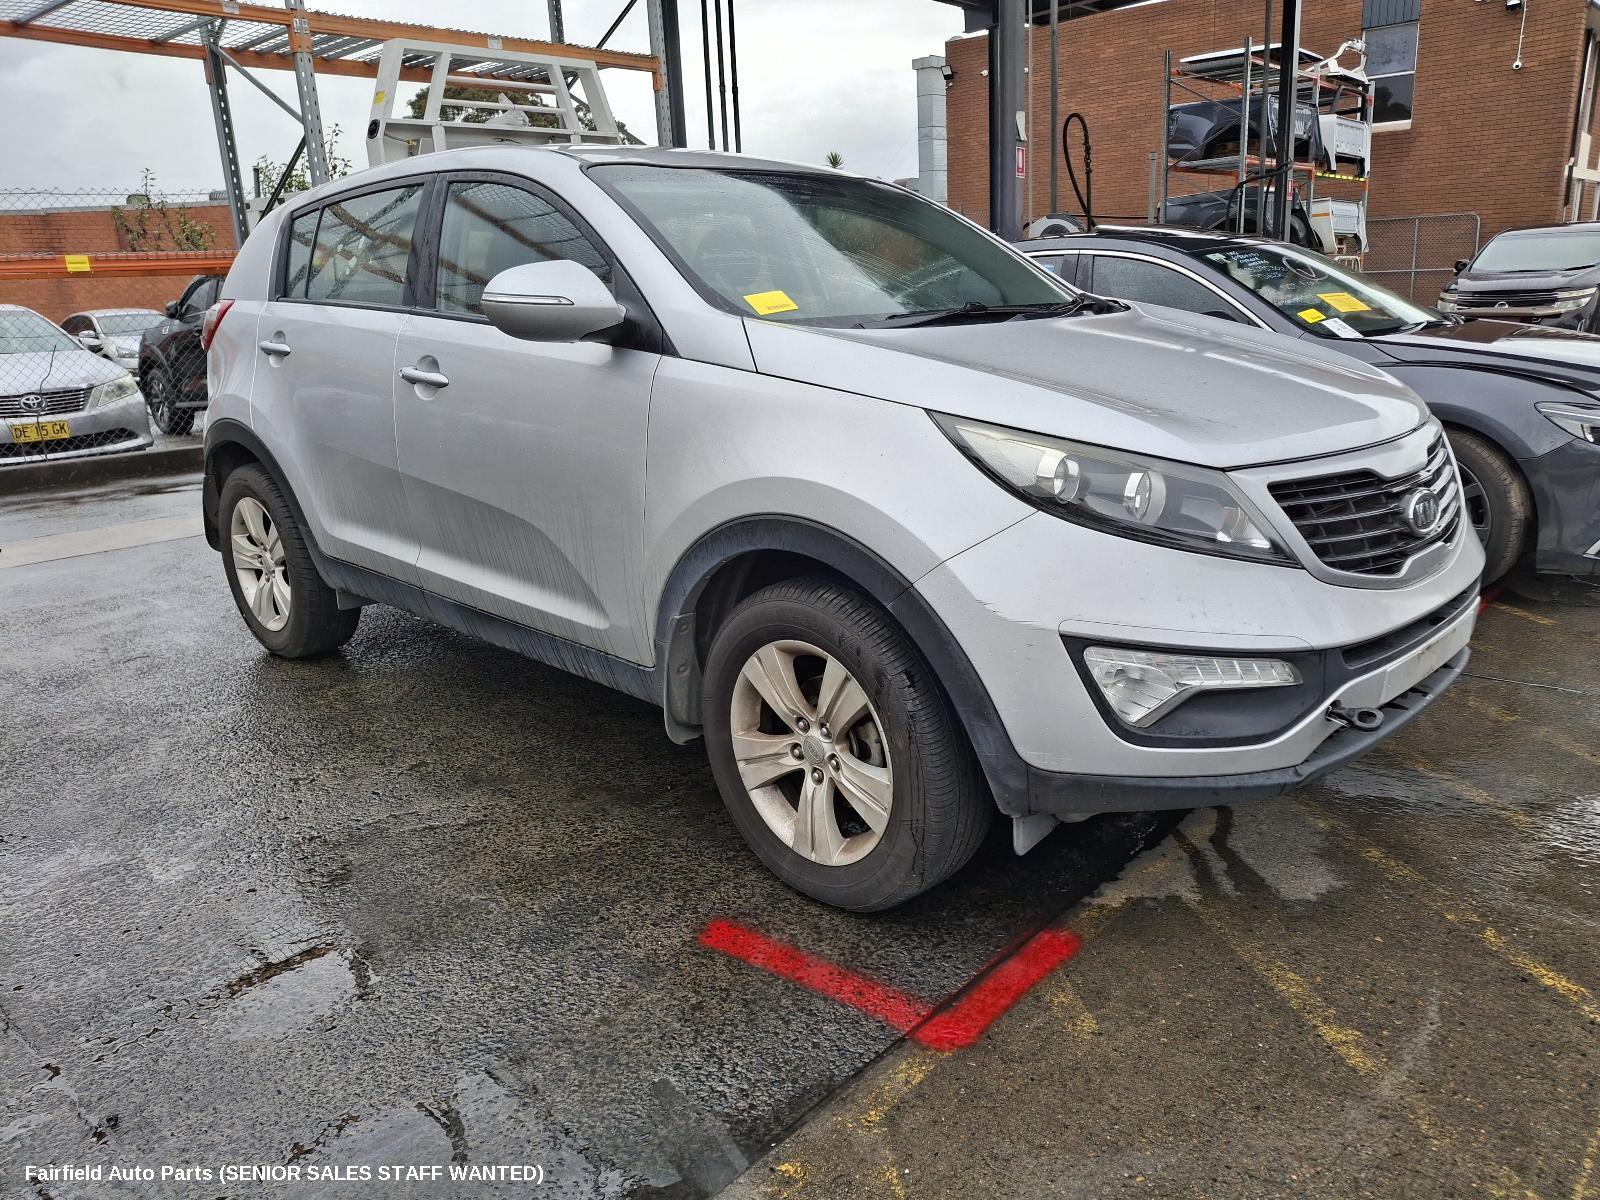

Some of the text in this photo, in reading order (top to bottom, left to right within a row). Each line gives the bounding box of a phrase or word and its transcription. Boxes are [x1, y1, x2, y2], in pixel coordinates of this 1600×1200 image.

[14, 422, 67, 439] DE 15 GK
